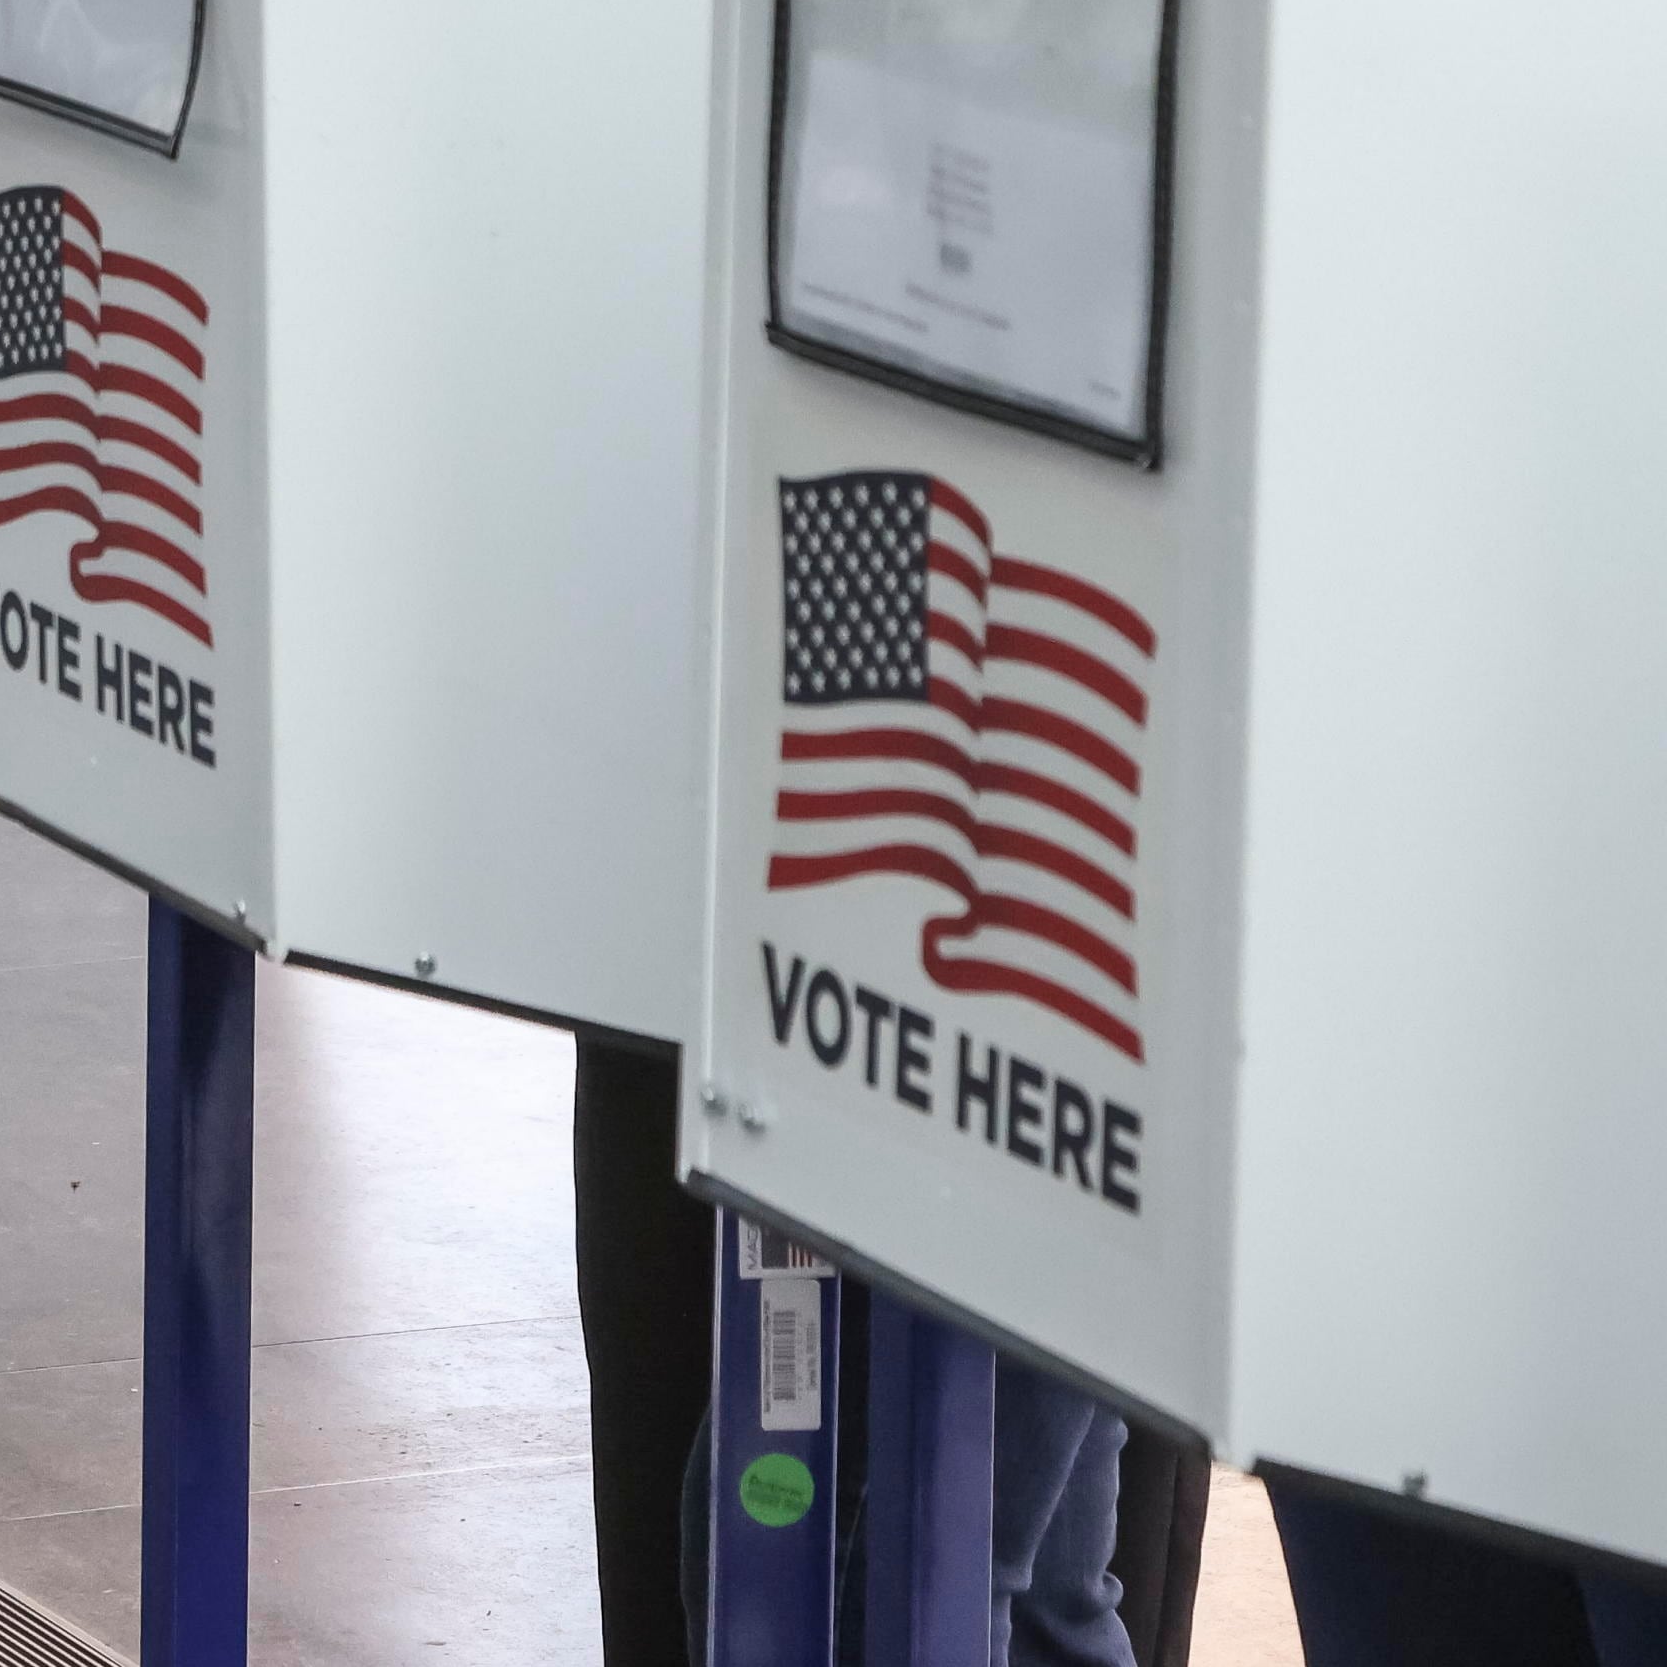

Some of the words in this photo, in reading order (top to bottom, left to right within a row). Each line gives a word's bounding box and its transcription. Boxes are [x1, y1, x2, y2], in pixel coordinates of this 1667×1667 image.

[95, 633, 216, 768] HERE
[761, 940, 933, 1116] VOTE
[954, 1029, 1143, 1216] HERE
